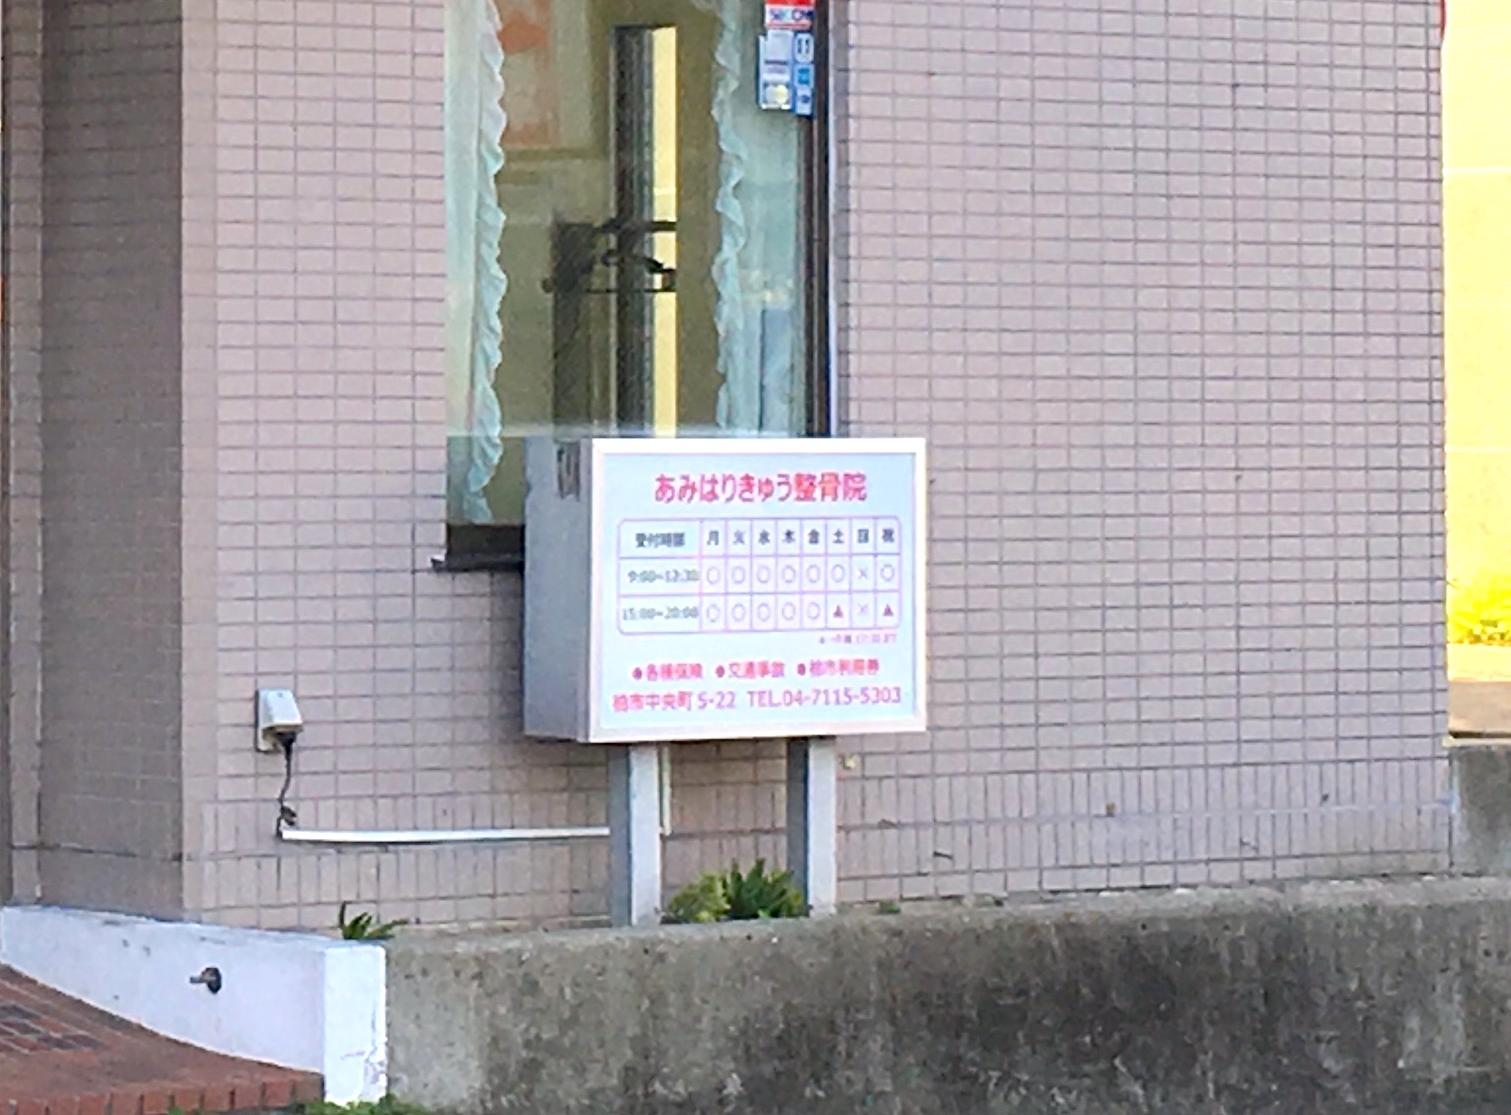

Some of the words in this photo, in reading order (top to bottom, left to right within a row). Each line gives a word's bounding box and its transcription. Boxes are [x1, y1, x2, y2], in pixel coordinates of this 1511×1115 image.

[654, 472, 867, 503] あみはりきゅう整骨院
[707, 530, 719, 545] 月
[758, 529, 770, 545] 水
[782, 529, 795, 544] 木
[808, 528, 820, 544] 金
[833, 528, 844, 544] 土
